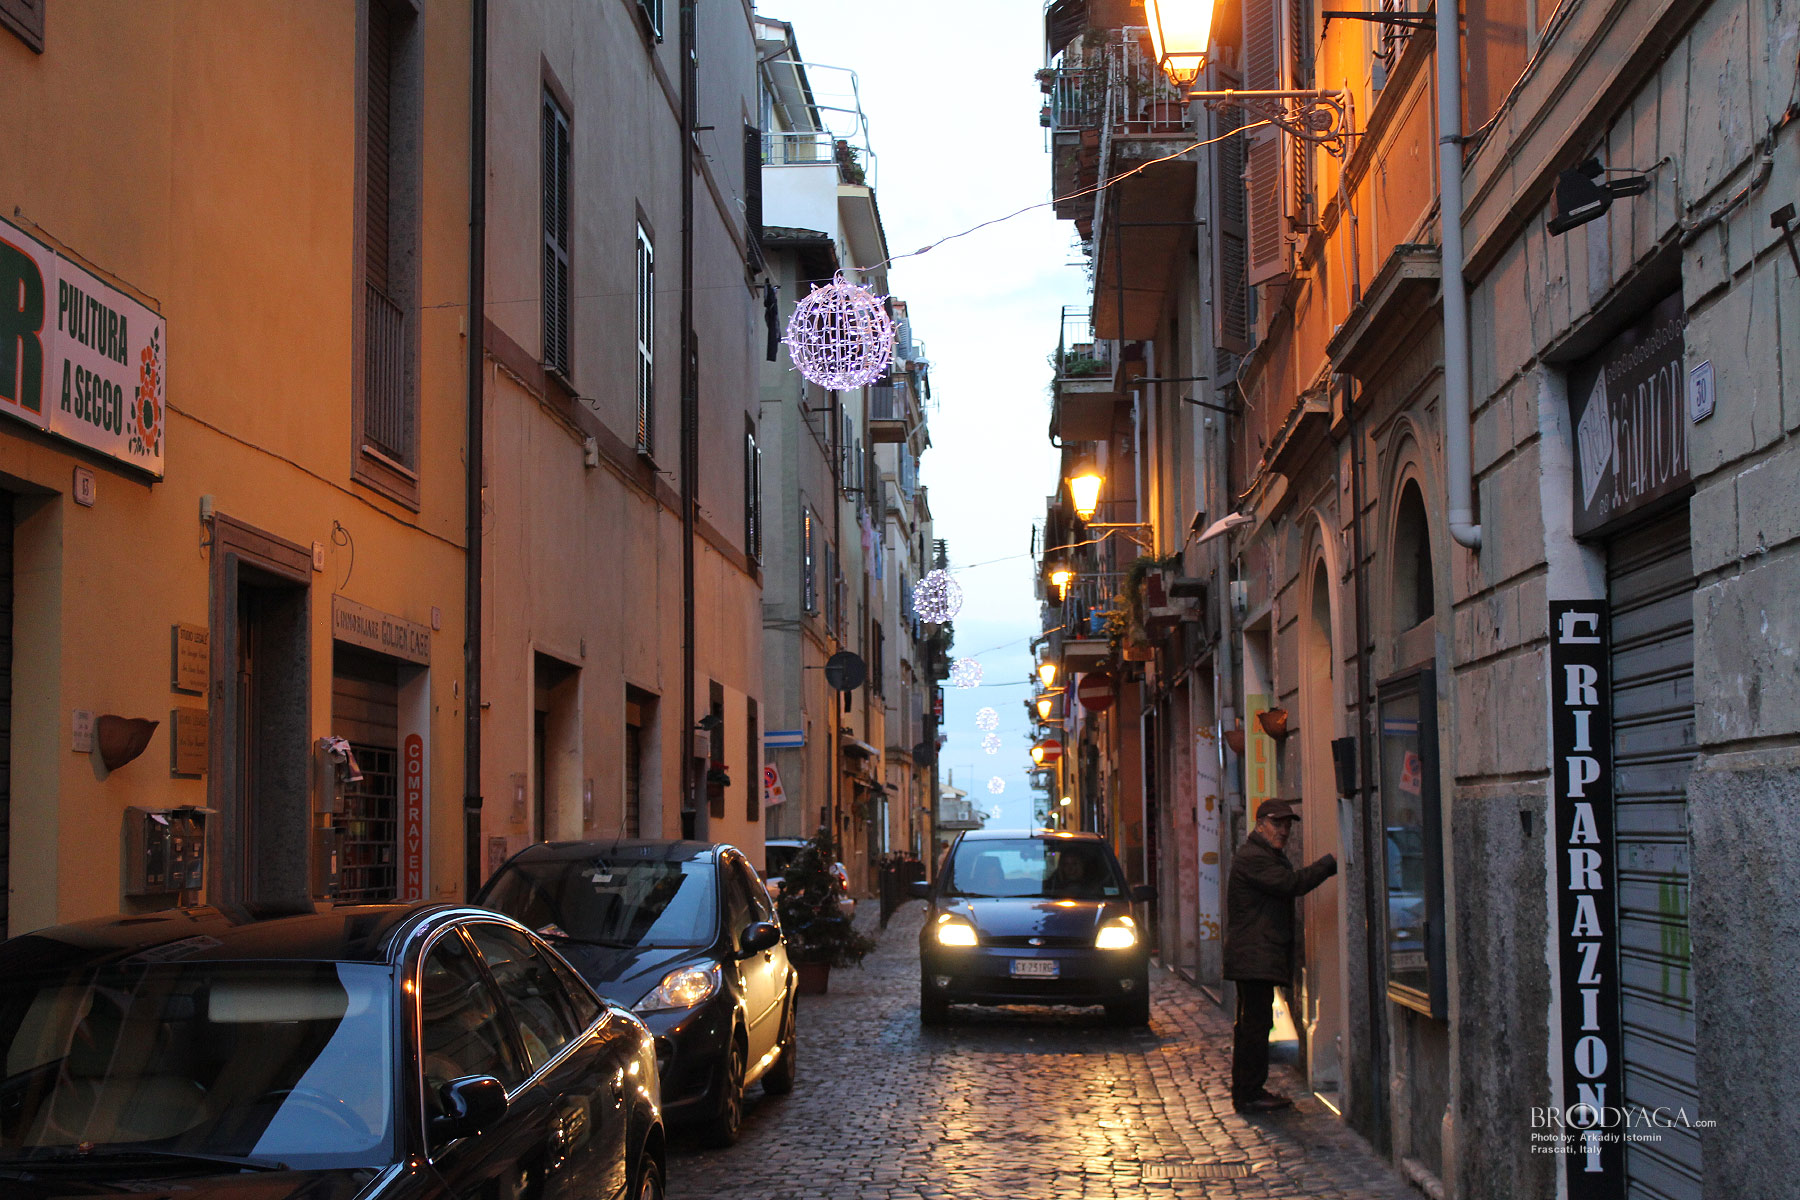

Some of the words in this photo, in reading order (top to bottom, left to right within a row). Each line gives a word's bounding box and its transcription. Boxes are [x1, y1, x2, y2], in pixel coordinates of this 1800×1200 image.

[58, 278, 128, 367] PULITURA
[61, 358, 71, 413] A
[74, 364, 123, 436] SECCO
[1696, 378, 1707, 407] 30
[382, 620, 408, 651] GOLDEN
[411, 630, 428, 657] CASE
[407, 744, 420, 900] COMPRAVEND
[1563, 664, 1608, 1173] RIPARAZIONI
